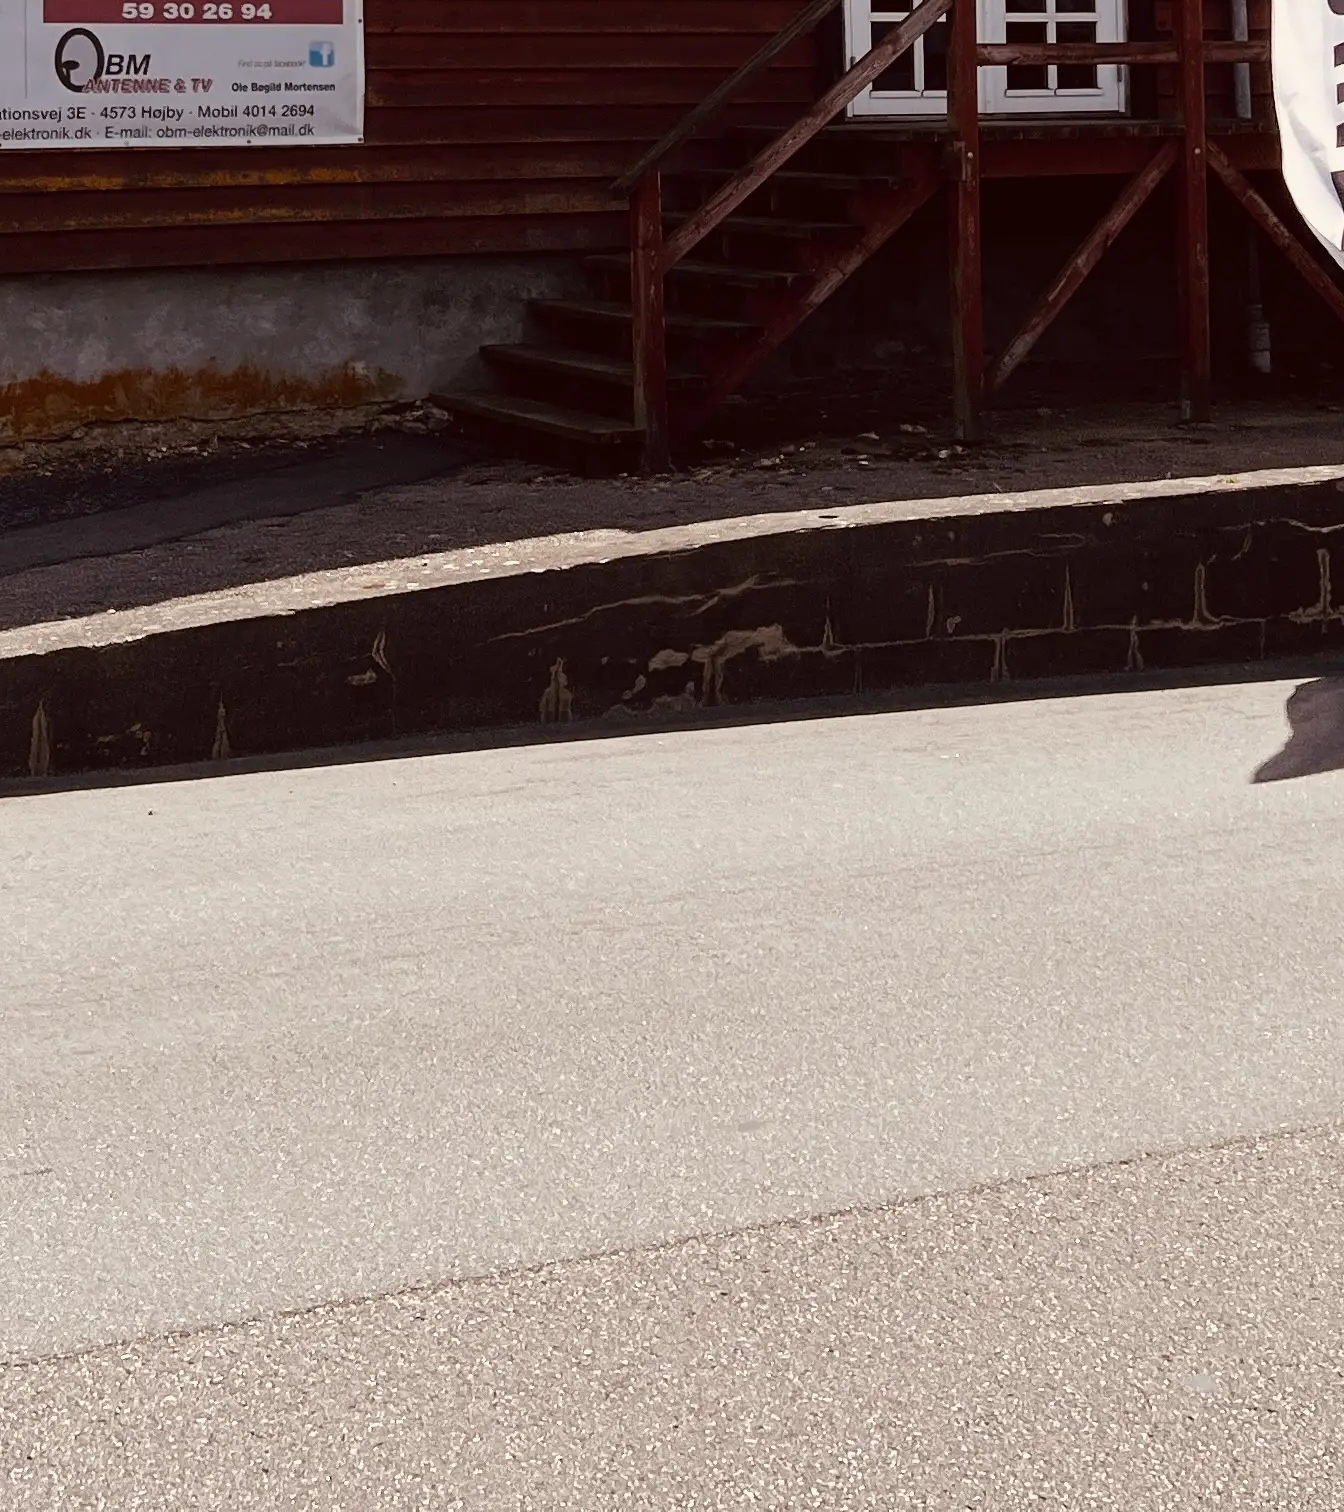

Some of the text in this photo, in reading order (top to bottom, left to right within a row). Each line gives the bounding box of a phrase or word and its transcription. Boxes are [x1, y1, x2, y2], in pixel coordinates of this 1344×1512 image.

[121, 2, 273, 20] 59 30 26 94
[82, 78, 214, 94] ANTENNE & TV
[231, 82, 248, 92] Ole
[284, 82, 336, 92] Mortensen
[66, 106, 87, 120] 3E
[99, 105, 137, 119] 4573
[141, 105, 185, 122] Højby
[197, 104, 238, 119] Mobil
[242, 104, 276, 118] 4014
[281, 104, 315, 118] 2694
[105, 125, 153, 139] E-mail:
[156, 123, 315, 138] obm-elektronik@mail.dk
